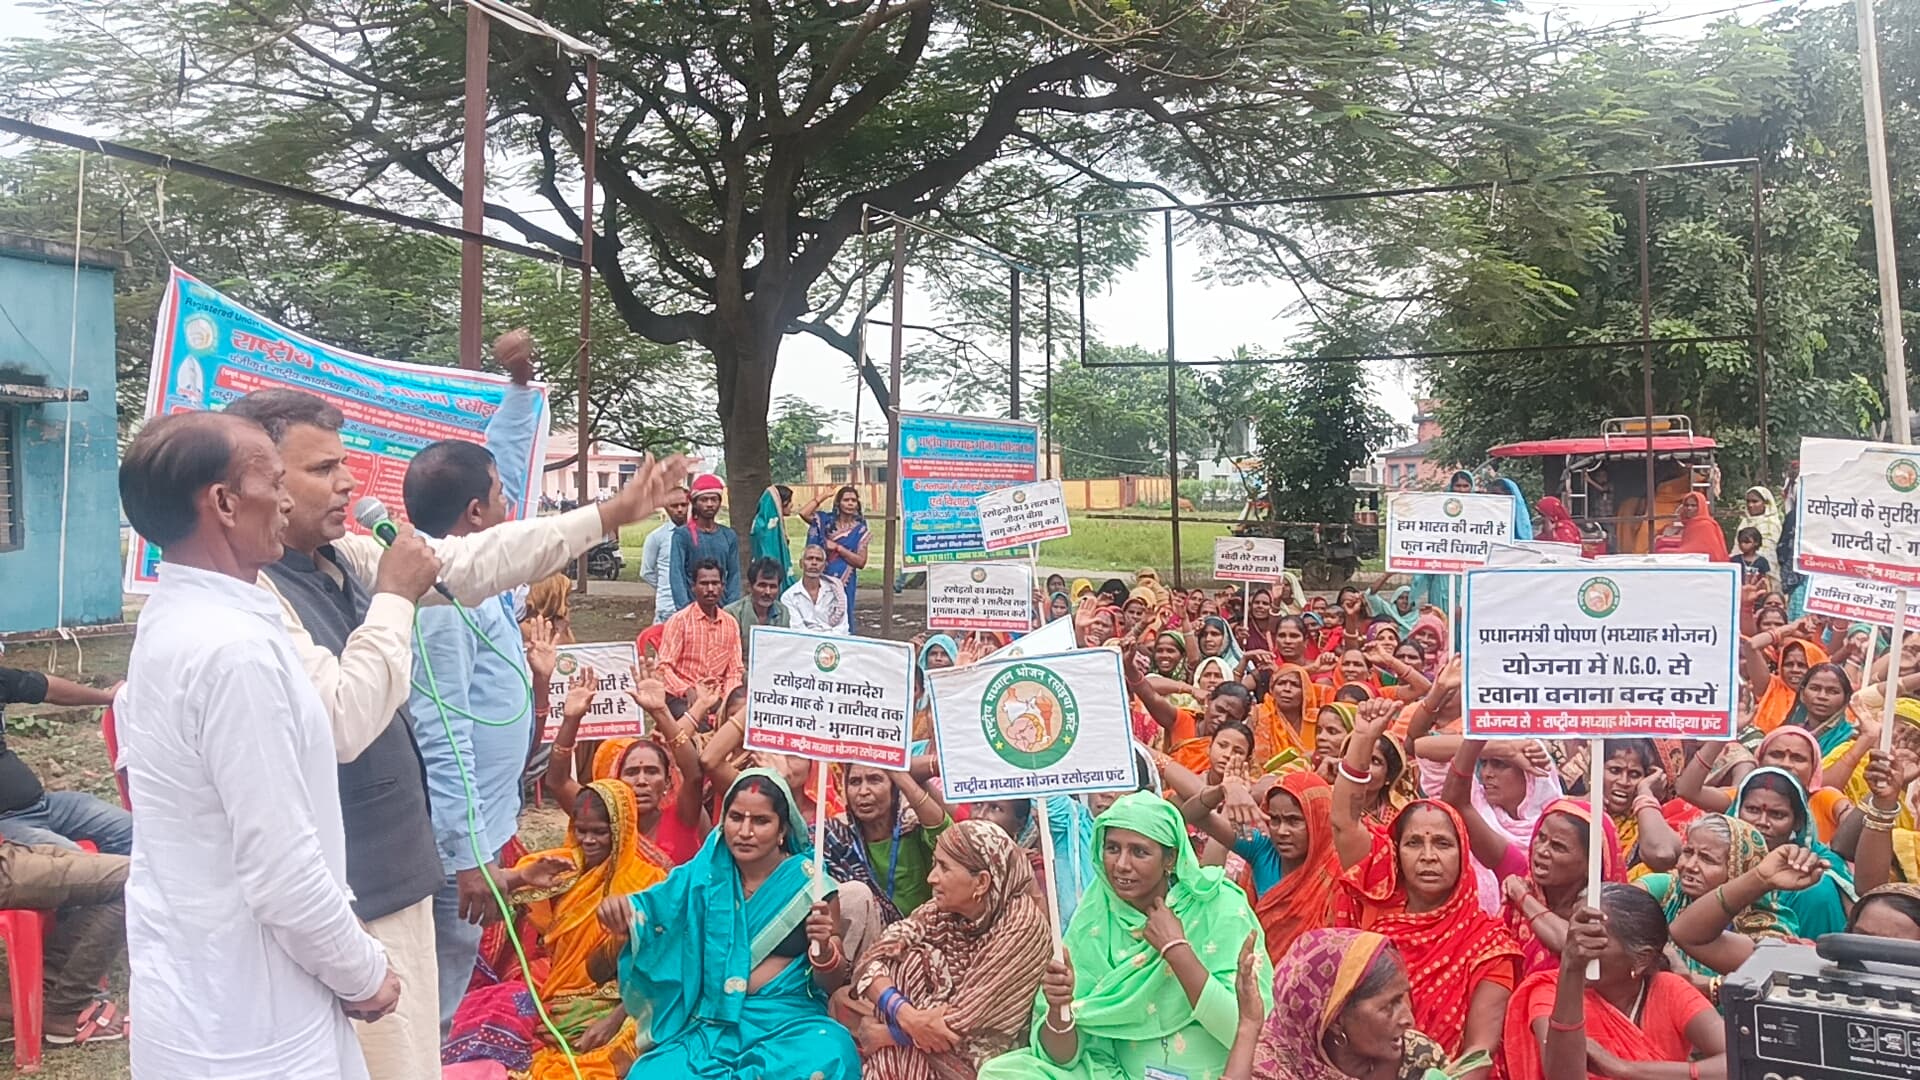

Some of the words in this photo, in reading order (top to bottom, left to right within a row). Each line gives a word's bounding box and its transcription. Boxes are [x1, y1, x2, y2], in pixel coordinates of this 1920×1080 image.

[185, 297, 234, 319] Registered
[233, 329, 313, 368] राष्ट्रीय
[1860, 499, 1875, 519] के
[1878, 502, 1920, 529] सुरक्षि
[1397, 519, 1416, 531] हम
[1418, 520, 1450, 533] भारत
[1451, 518, 1467, 534] की
[1469, 520, 1494, 535] नारी
[1400, 540, 1422, 556] फूल
[1831, 530, 1873, 552] गारन्टी
[1876, 533, 1892, 555] दो
[1814, 587, 1851, 601] शामिल
[1479, 623, 1550, 645] प्रधानमंत्री
[1554, 623, 1597, 643] पोषण
[1661, 623, 1718, 646] भोजन)
[1502, 652, 1583, 675] योजना
[1587, 652, 1609, 675] में
[1613, 655, 1661, 675] N.G.O.
[1667, 652, 1693, 676] से
[817, 679, 834, 693] का
[836, 680, 884, 699] मानदेश
[1477, 687, 1540, 704] खाना
[1543, 687, 1614, 704] बनाना
[1618, 687, 1666, 706] बन्द
[1669, 681, 1719, 705] करों
[753, 689, 789, 706] प्रत्येक
[790, 696, 812, 710] माह
[813, 695, 824, 712] के
[828, 702, 834, 713] 1
[837, 700, 879, 719] तारीख
[881, 707, 905, 721] तक
[753, 711, 794, 728] भुगतान
[795, 714, 816, 731] करो
[828, 722, 875, 739] भुगतान
[876, 725, 902, 742] करो
[1475, 711, 1518, 728] सौजन्य
[1520, 711, 1532, 728] से
[1542, 711, 1579, 732] राष्ट्रीय
[1618, 711, 1653, 728] भोजन
[1654, 711, 1700, 731] रसोइया
[953, 776, 988, 794] राष्ट्रीय
[1026, 772, 1059, 787] भोजन
[1061, 768, 1104, 785] रसोइया
